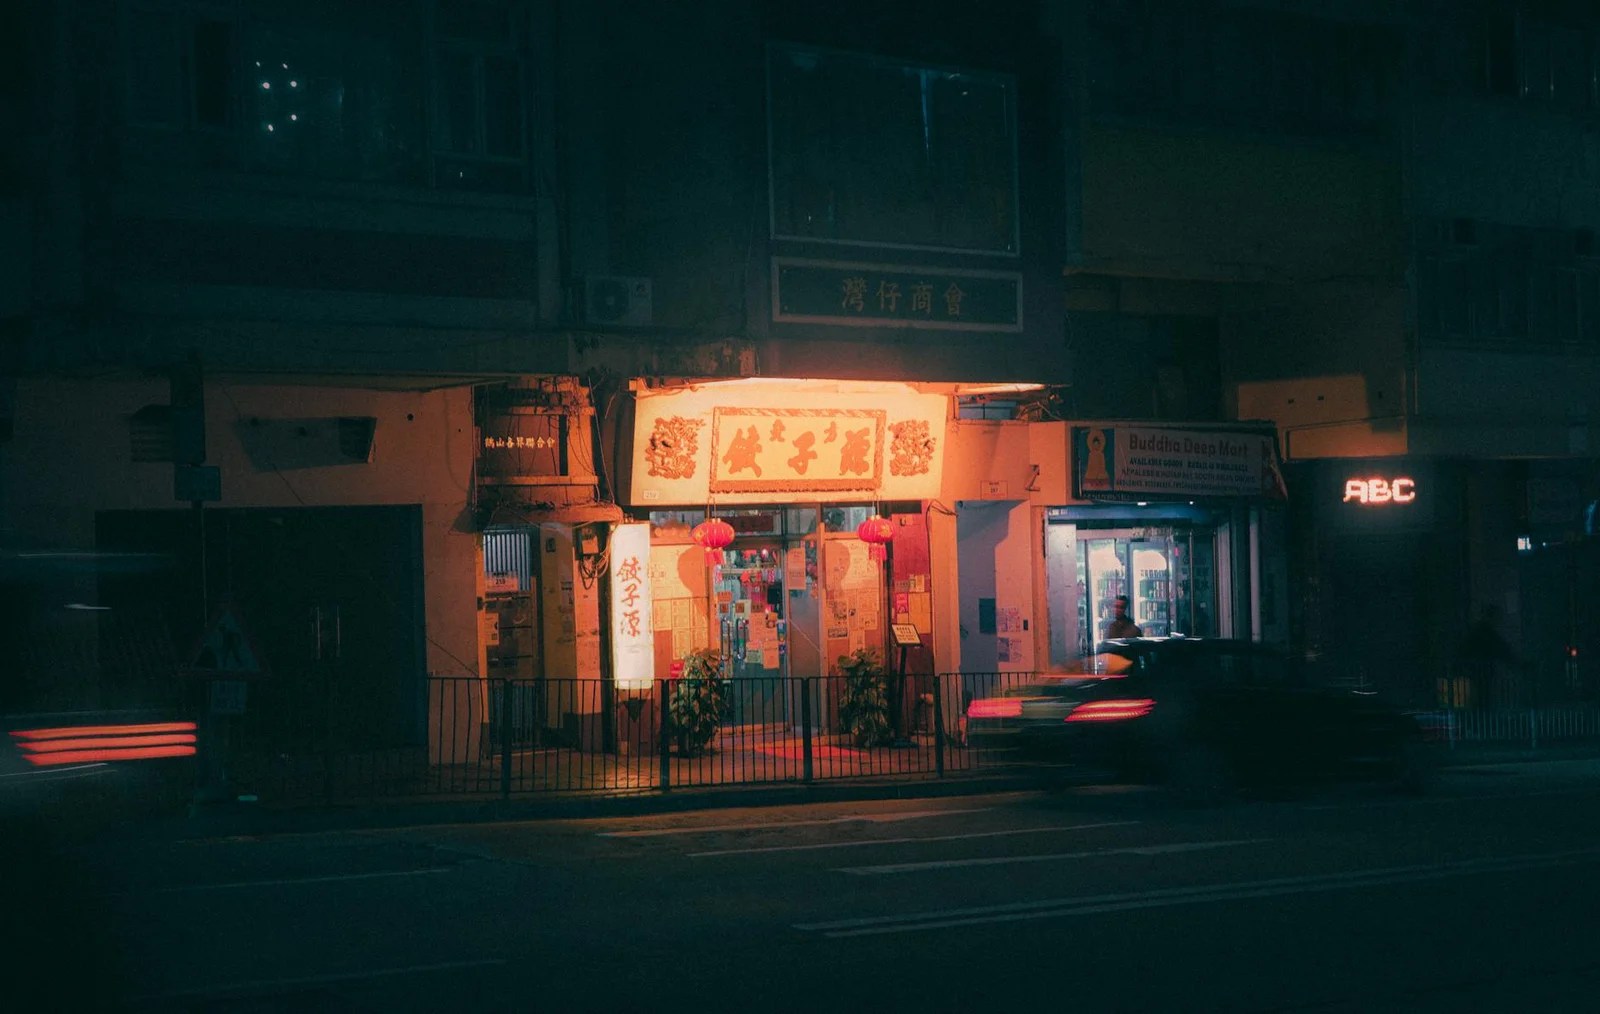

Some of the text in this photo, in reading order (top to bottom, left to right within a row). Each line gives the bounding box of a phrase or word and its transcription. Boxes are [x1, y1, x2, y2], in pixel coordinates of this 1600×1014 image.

[842, 276, 967, 317] 灣仔商會
[1129, 433, 1249, 458] Buddha Deep Mart
[1343, 478, 1416, 504] ABC
